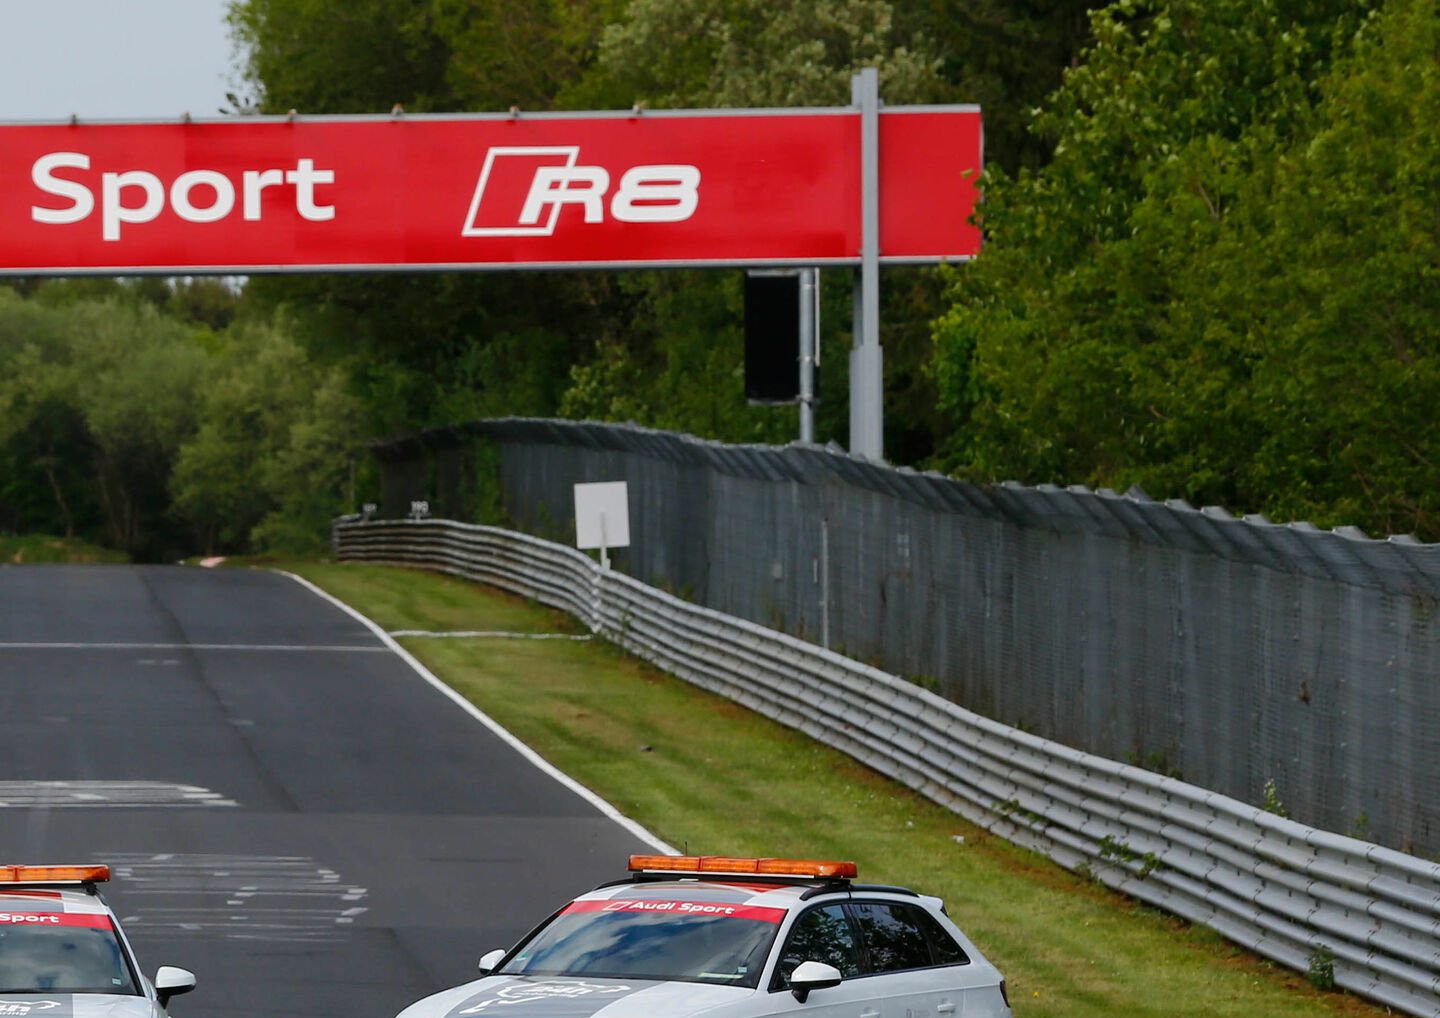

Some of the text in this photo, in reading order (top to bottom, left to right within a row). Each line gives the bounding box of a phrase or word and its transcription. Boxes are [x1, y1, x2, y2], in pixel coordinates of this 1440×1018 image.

[31, 152, 336, 242] Sport
[519, 164, 701, 225] R8
[629, 901, 735, 915] Audi Sport
